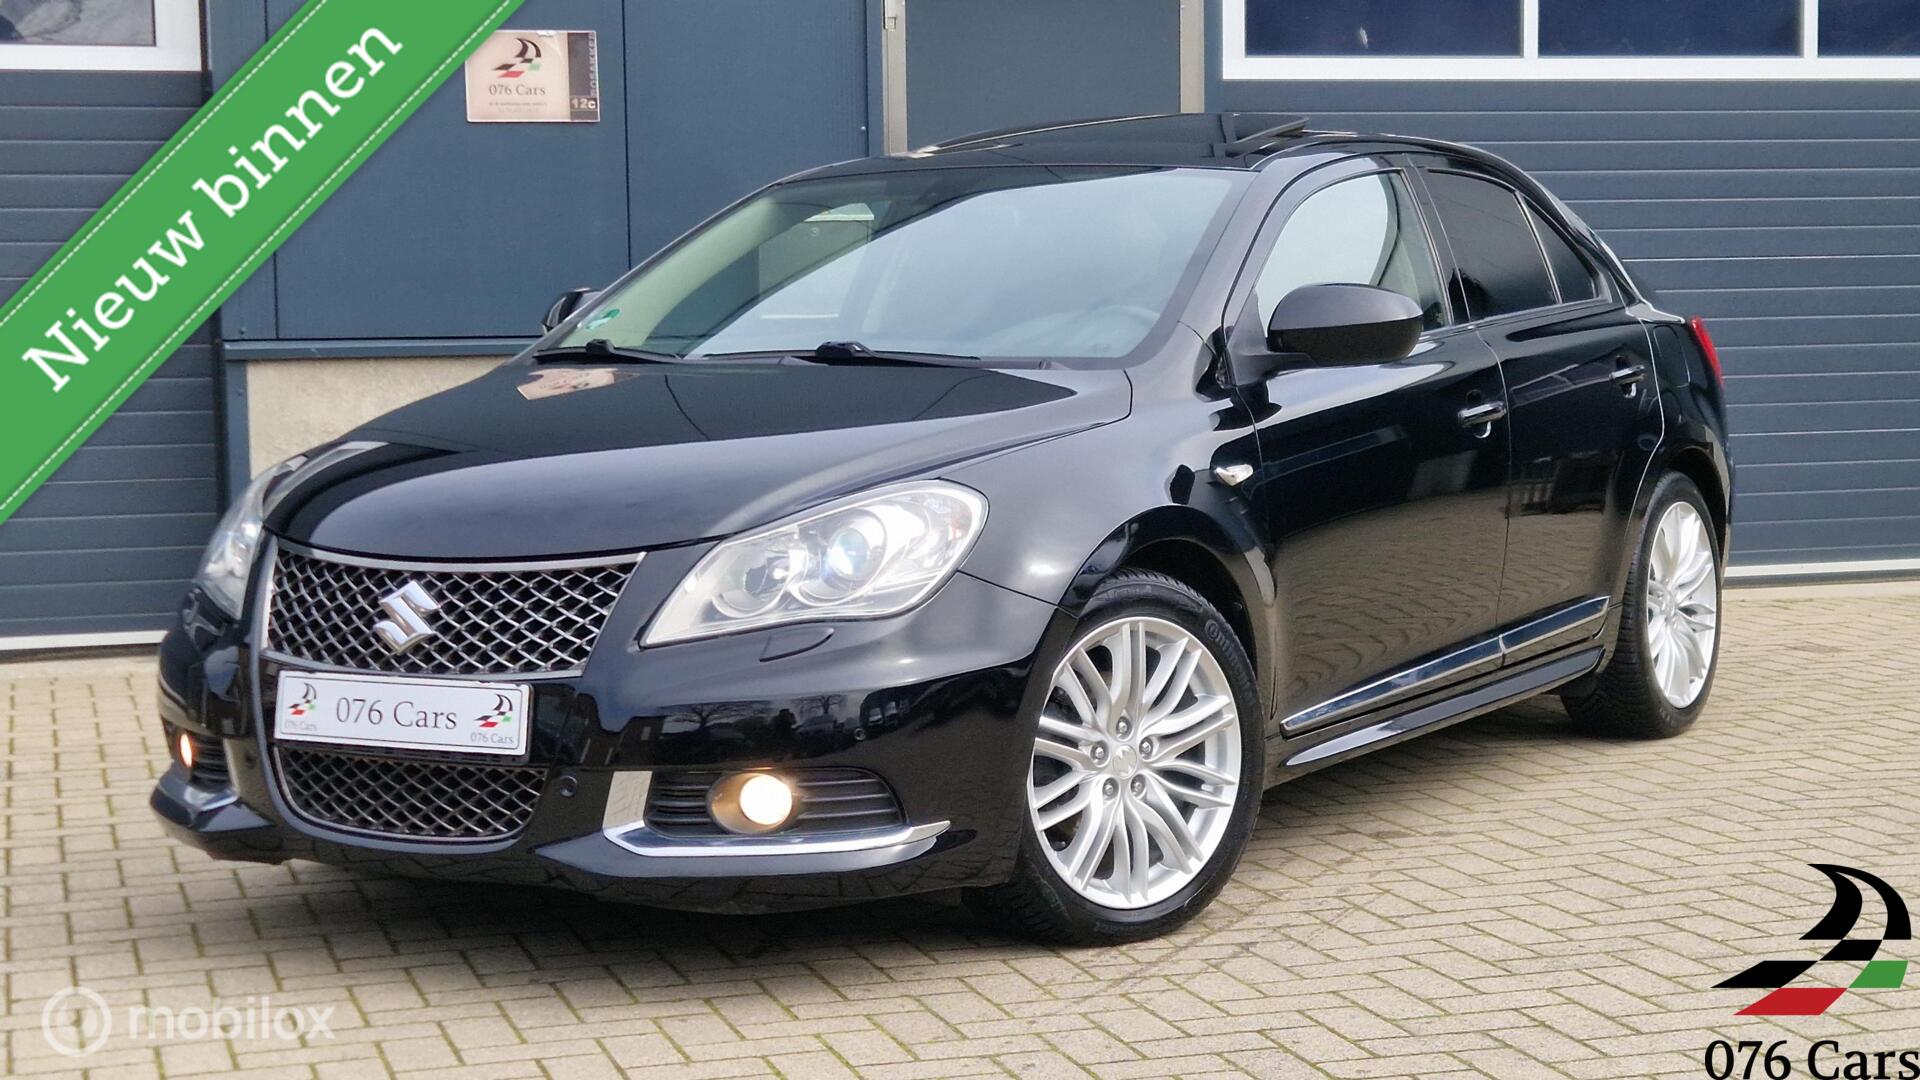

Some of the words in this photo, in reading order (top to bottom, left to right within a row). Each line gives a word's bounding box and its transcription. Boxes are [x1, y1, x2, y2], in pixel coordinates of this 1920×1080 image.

[489, 84, 512, 96] 076
[516, 84, 546, 96] Cars
[571, 98, 597, 109] 12c
[335, 697, 383, 725] 076
[393, 701, 458, 730] Cars
[470, 732, 489, 743] 076
[491, 734, 514, 745] Cars
